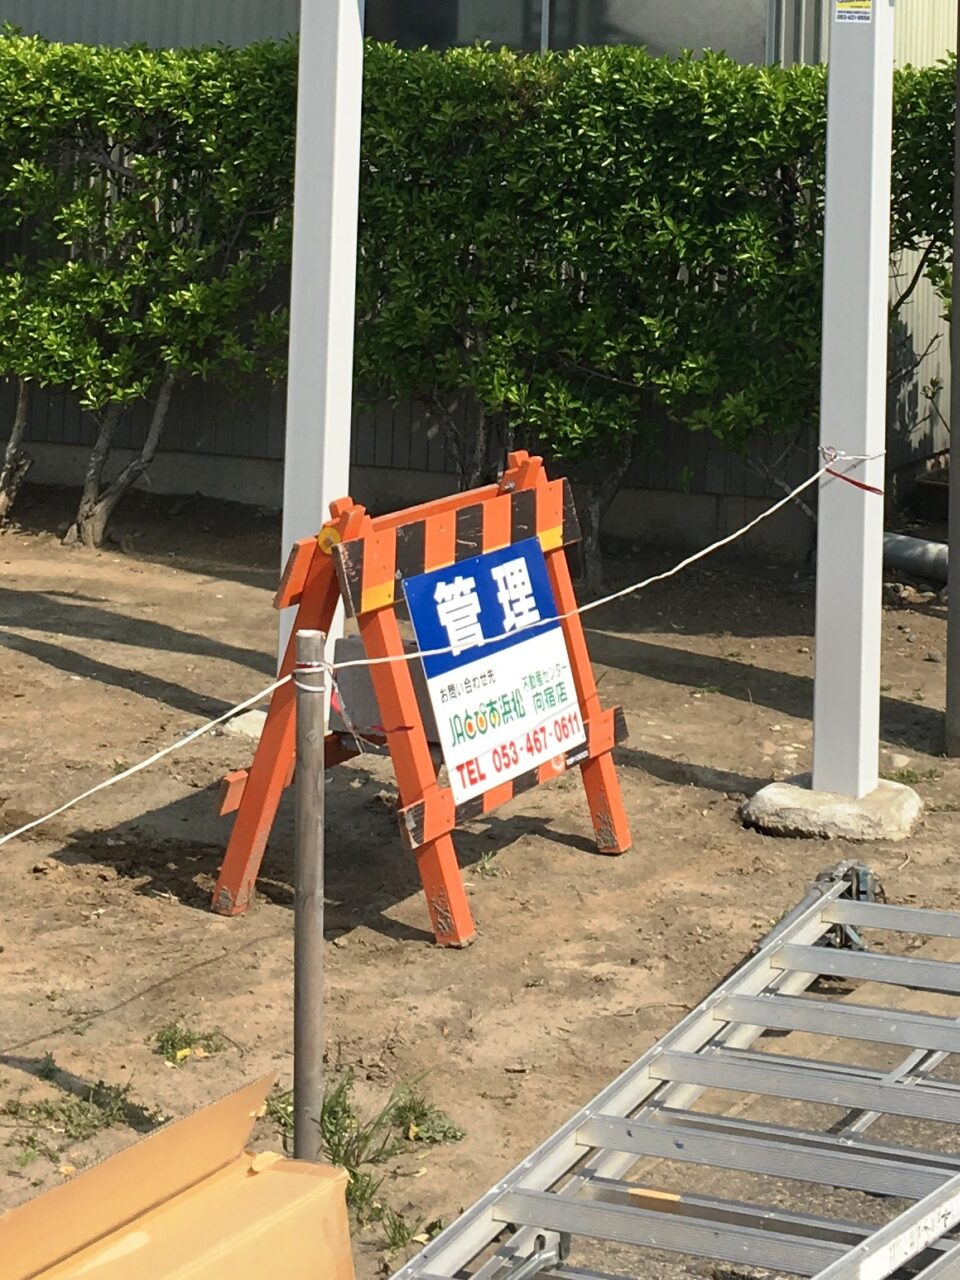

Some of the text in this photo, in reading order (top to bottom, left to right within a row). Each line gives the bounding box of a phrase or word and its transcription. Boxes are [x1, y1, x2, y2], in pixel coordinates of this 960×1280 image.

[433, 556, 541, 657] 管理
[440, 669, 496, 703] お問い合わせ先
[455, 711, 581, 790] TEL 053-467-0611
